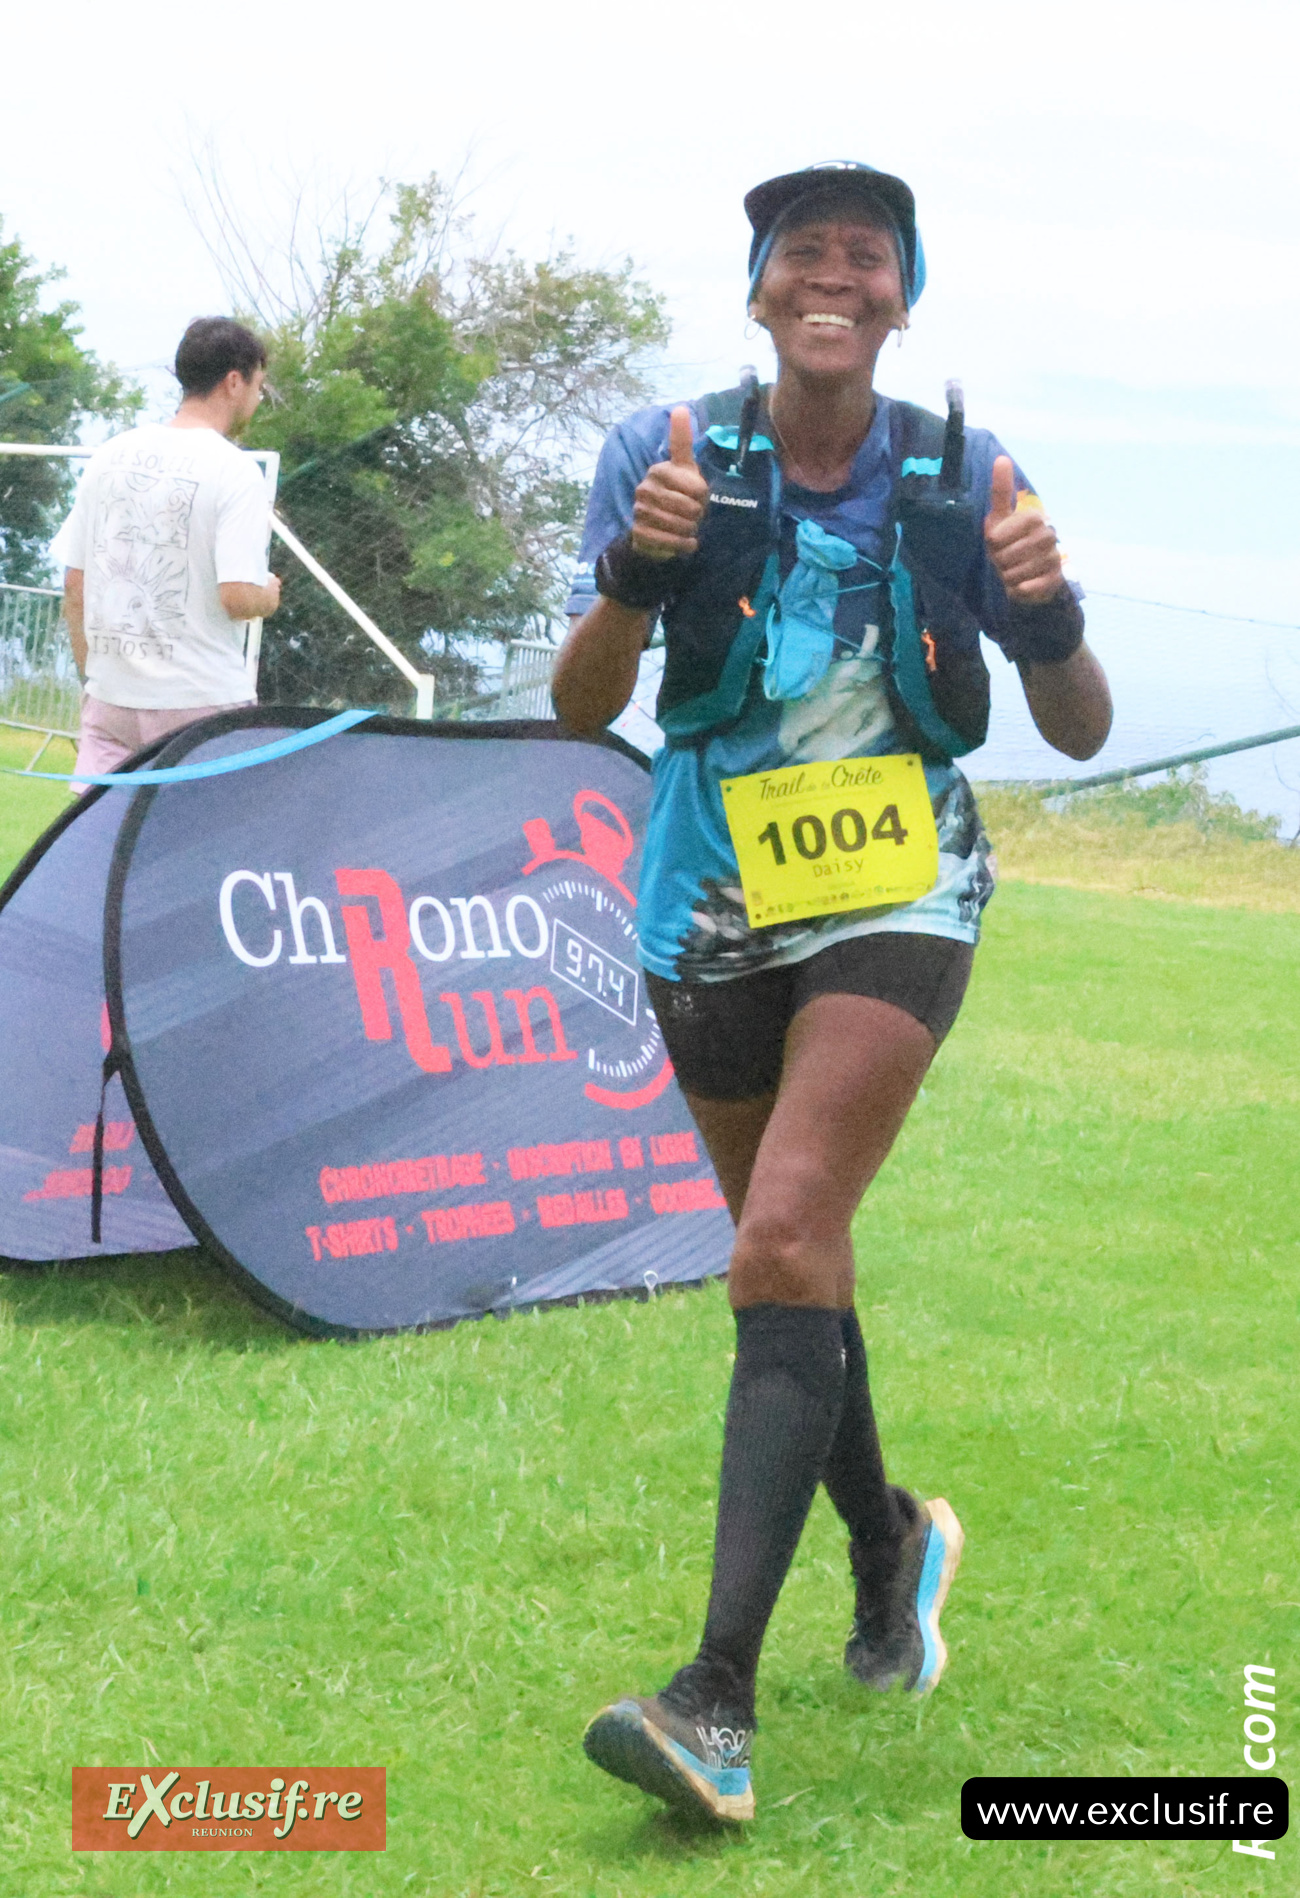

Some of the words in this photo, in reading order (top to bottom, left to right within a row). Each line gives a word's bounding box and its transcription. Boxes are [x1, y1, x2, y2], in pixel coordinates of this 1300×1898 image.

[709, 493, 758, 508] ALOMON
[760, 771, 806, 800] Trail
[831, 764, 883, 788] Crête
[758, 804, 909, 866] 1004
[812, 857, 865, 878] Daisy
